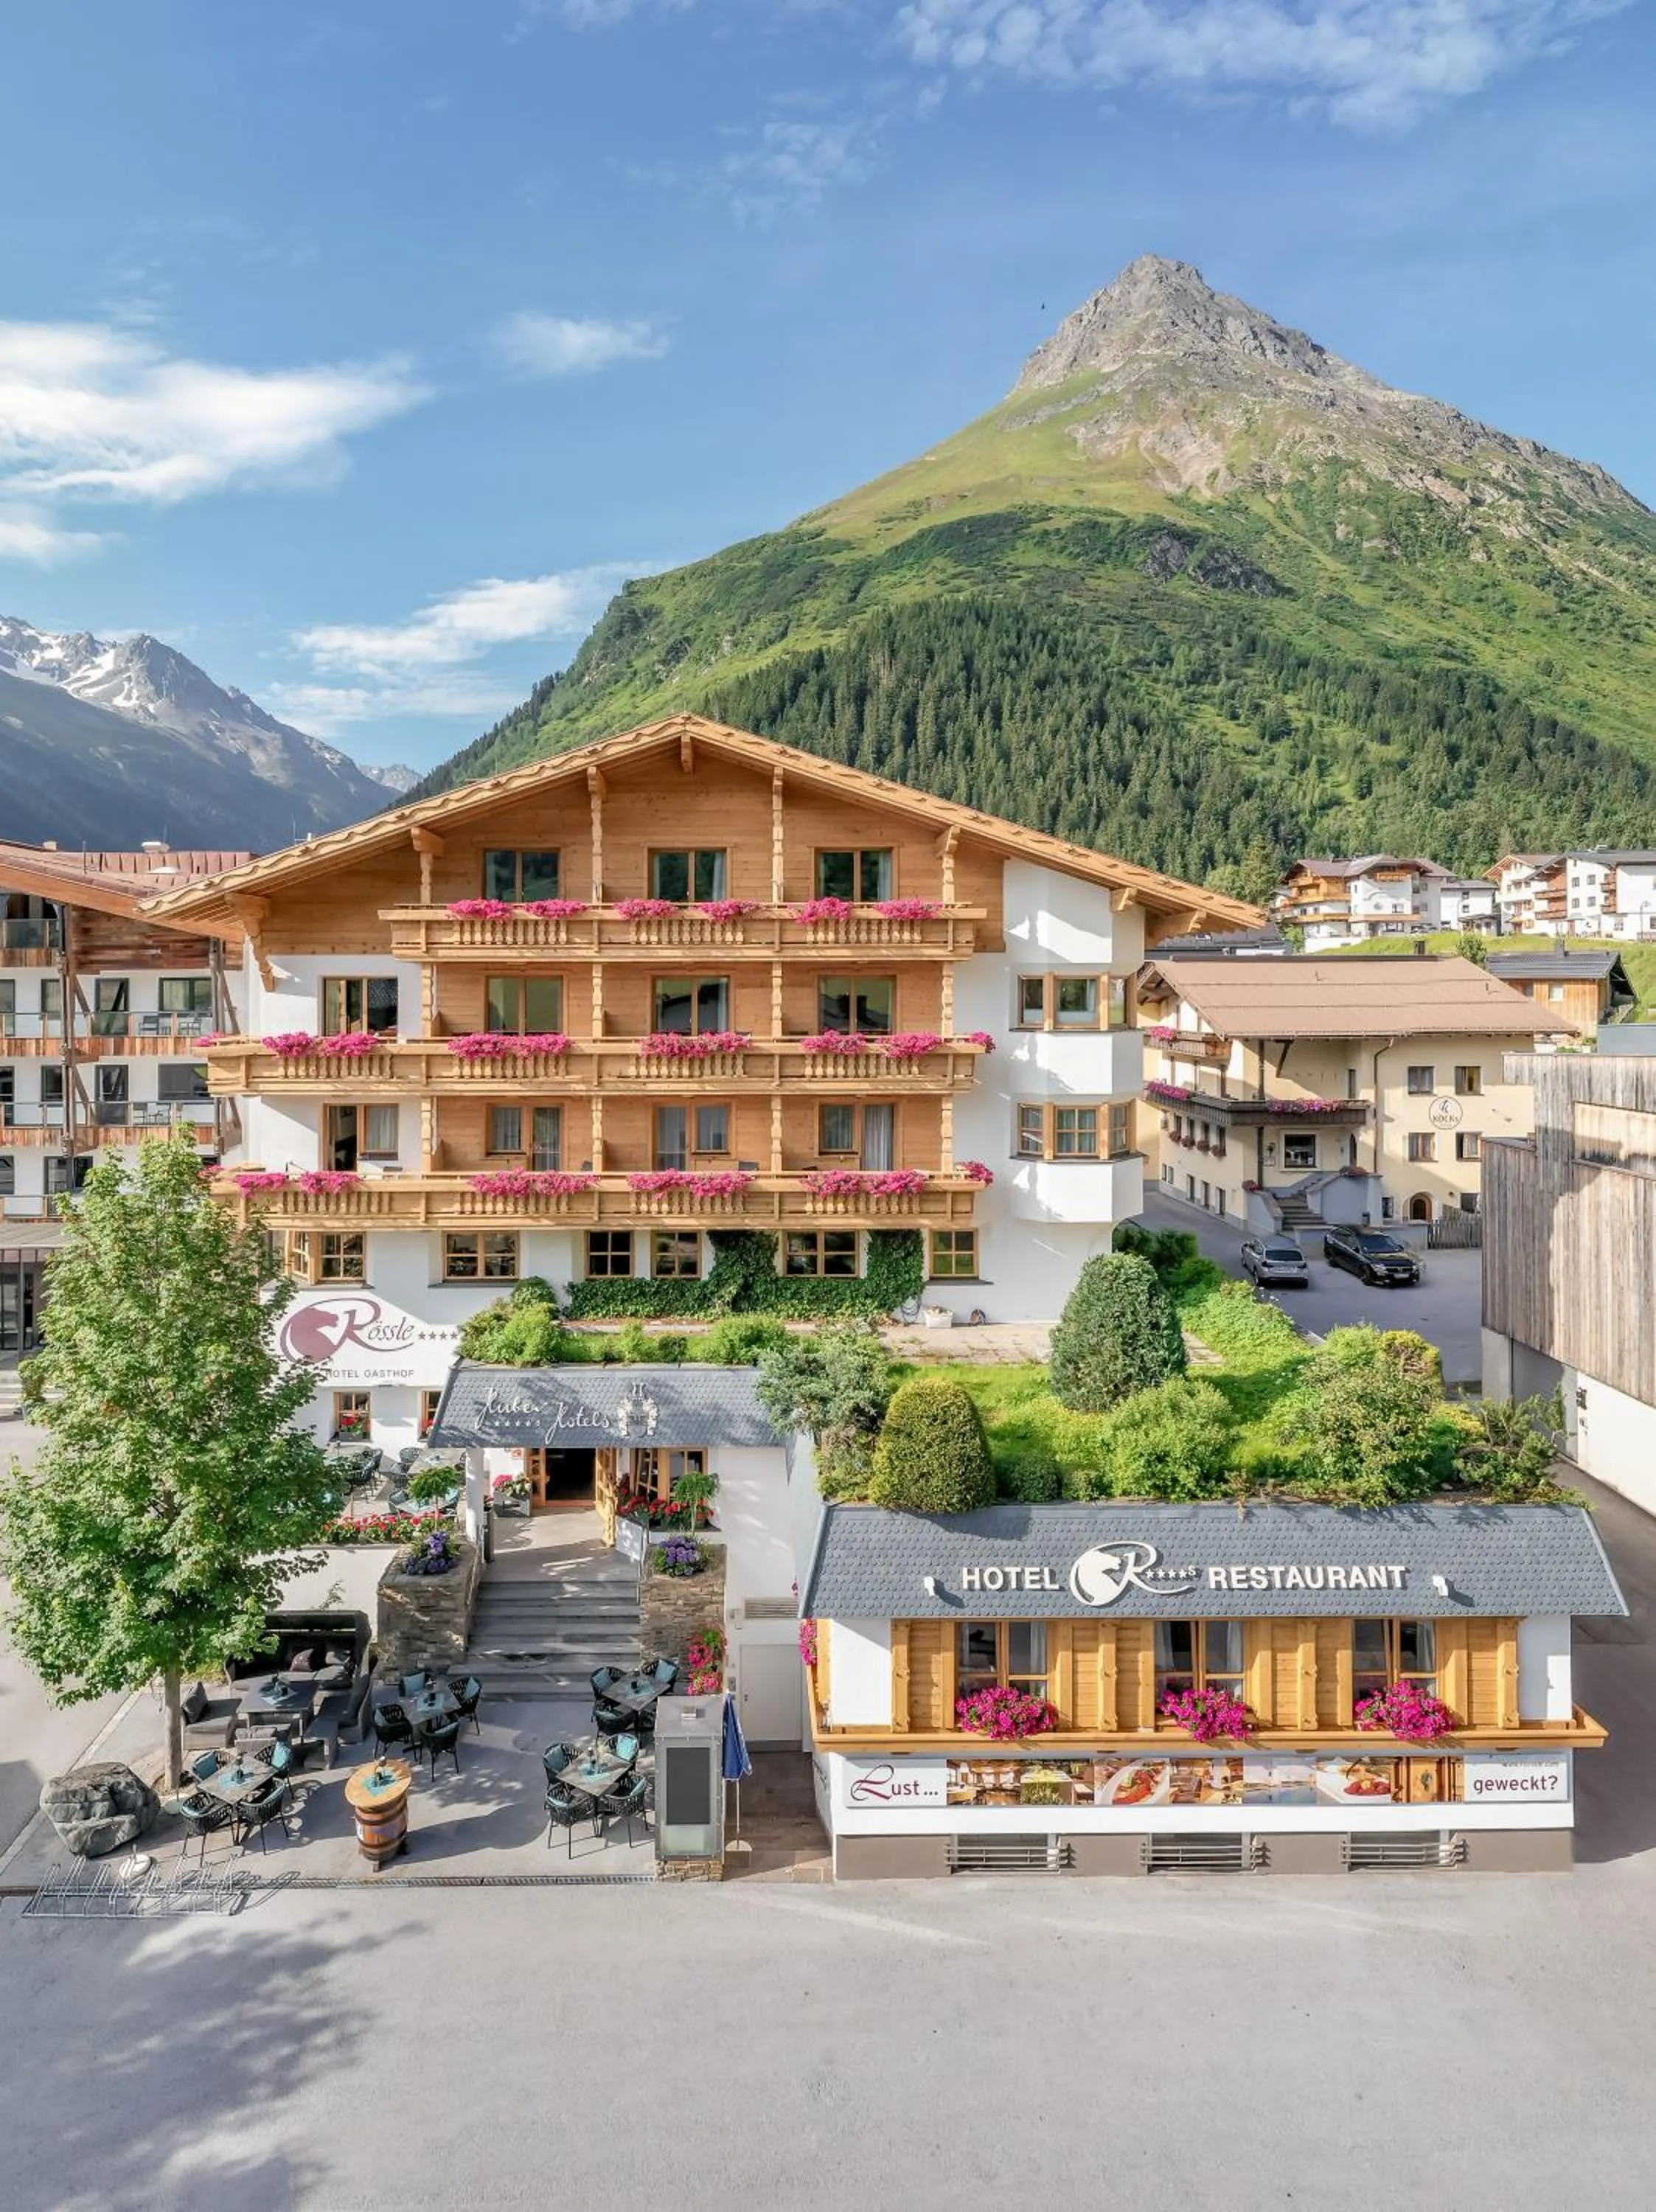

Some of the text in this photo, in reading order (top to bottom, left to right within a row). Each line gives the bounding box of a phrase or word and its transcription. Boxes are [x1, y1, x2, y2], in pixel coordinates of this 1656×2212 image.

[307, 1297, 414, 1352] Rössle
[326, 1369, 414, 1377] HOTEL GASTHOF
[545, 1402, 610, 1444] Hotels
[961, 1566, 1060, 1590] HOTEL
[1208, 1565, 1406, 1590] RESTAURANT
[1473, 1775, 1558, 1794] geweckt?
